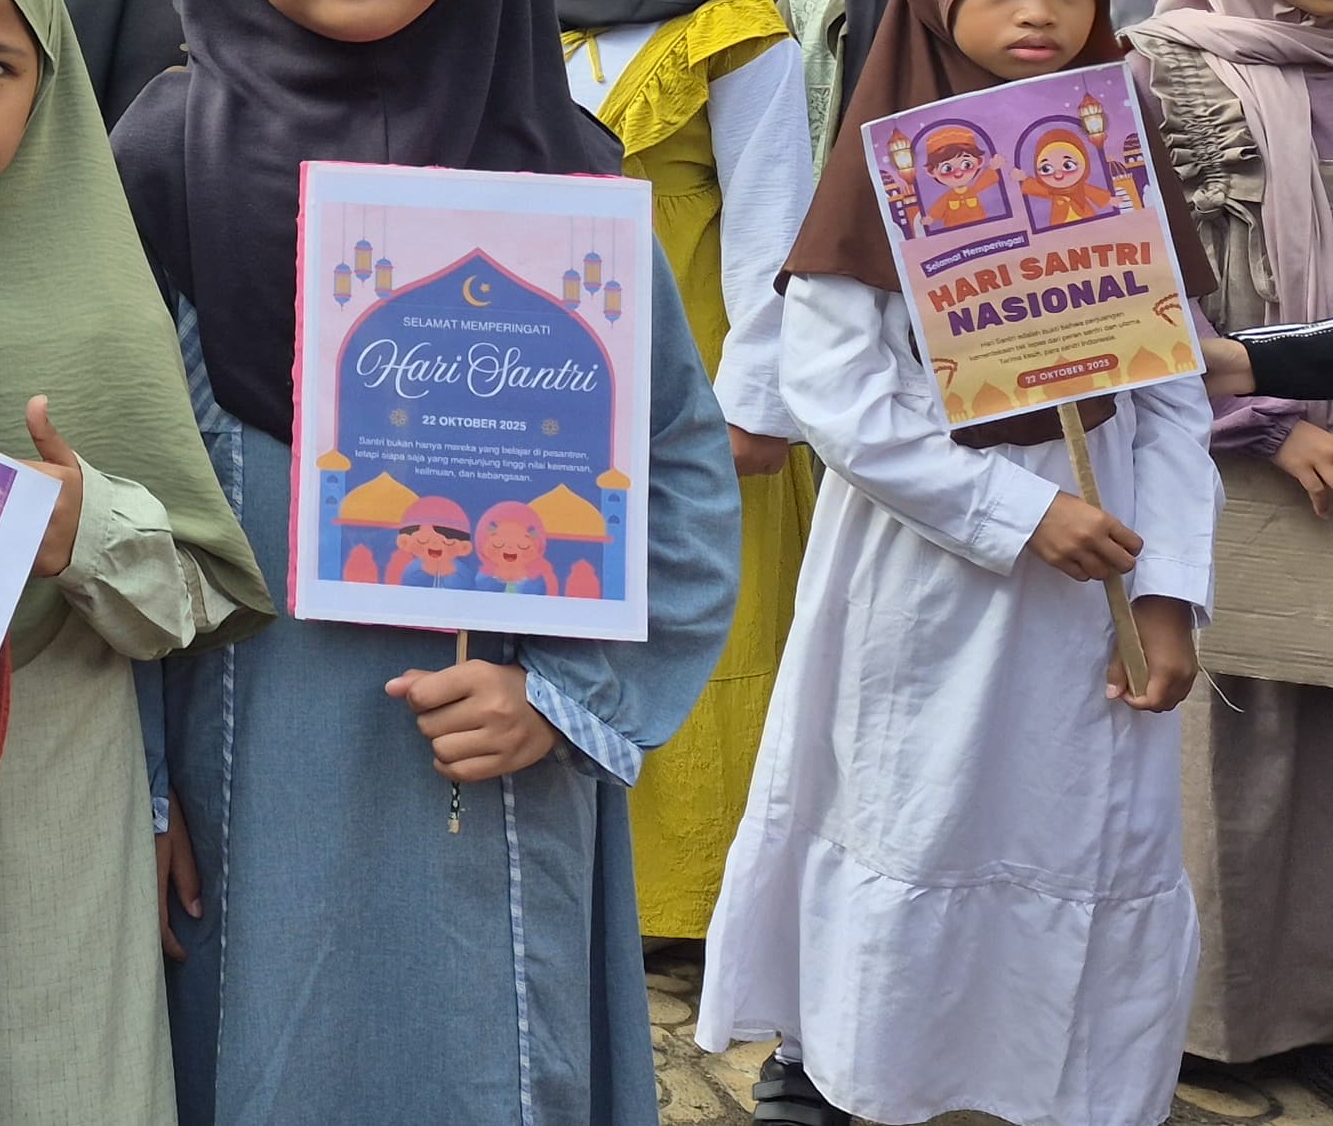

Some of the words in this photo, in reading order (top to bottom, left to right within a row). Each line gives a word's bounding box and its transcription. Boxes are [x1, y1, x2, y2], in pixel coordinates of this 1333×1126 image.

[925, 252, 962, 273] Selamat
[927, 258, 1013, 314] HARI
[1019, 240, 1152, 282] SANTRI
[947, 270, 1150, 338] NASIONAL
[402, 316, 459, 331] SELAMAT
[461, 319, 552, 336] MEMPERINGATI
[355, 338, 463, 400] Hari
[466, 341, 599, 399] Santri
[1024, 374, 1037, 385] 22
[1039, 363, 1085, 381] OKTOBER
[1086, 358, 1111, 371] 2025
[421, 414, 437, 426] 22
[438, 416, 498, 430] OKTOBER
[499, 419, 528, 432] 2025
